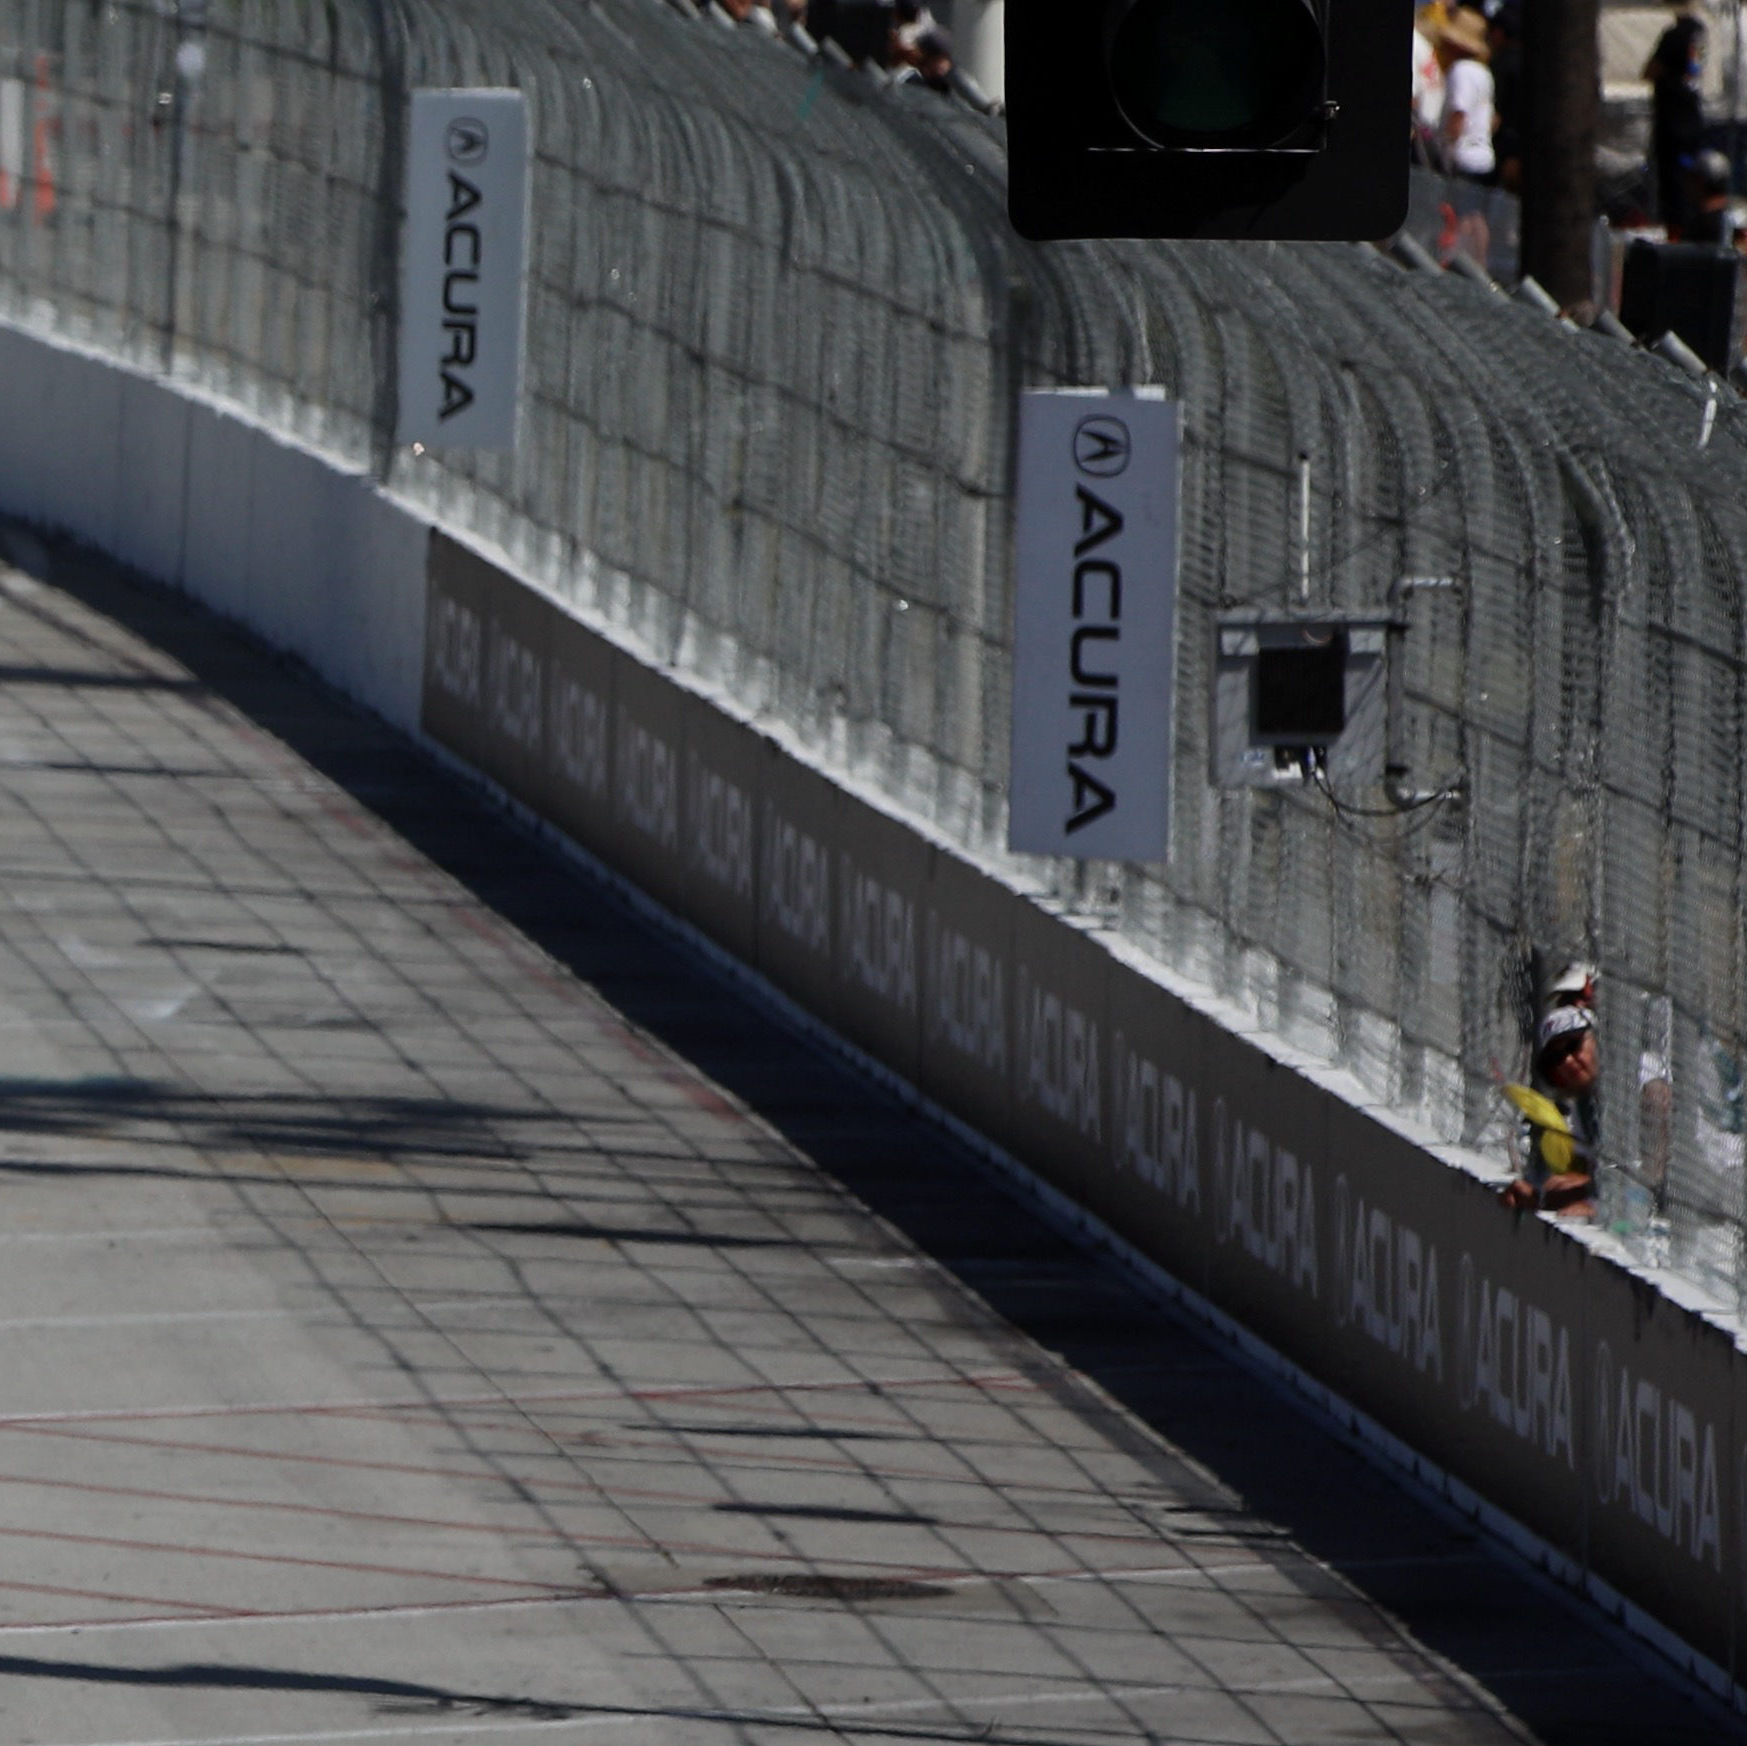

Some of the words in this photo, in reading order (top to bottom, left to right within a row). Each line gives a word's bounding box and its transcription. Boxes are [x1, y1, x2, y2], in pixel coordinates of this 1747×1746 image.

[438, 172, 483, 423] ACURA
[1063, 484, 1125, 836] ACURA
[1229, 1118, 1318, 1298] ACURA
[1352, 1200, 1443, 1382] ACURA
[1472, 1280, 1574, 1470] ACURA
[1612, 1367, 1722, 1573] ACURA
